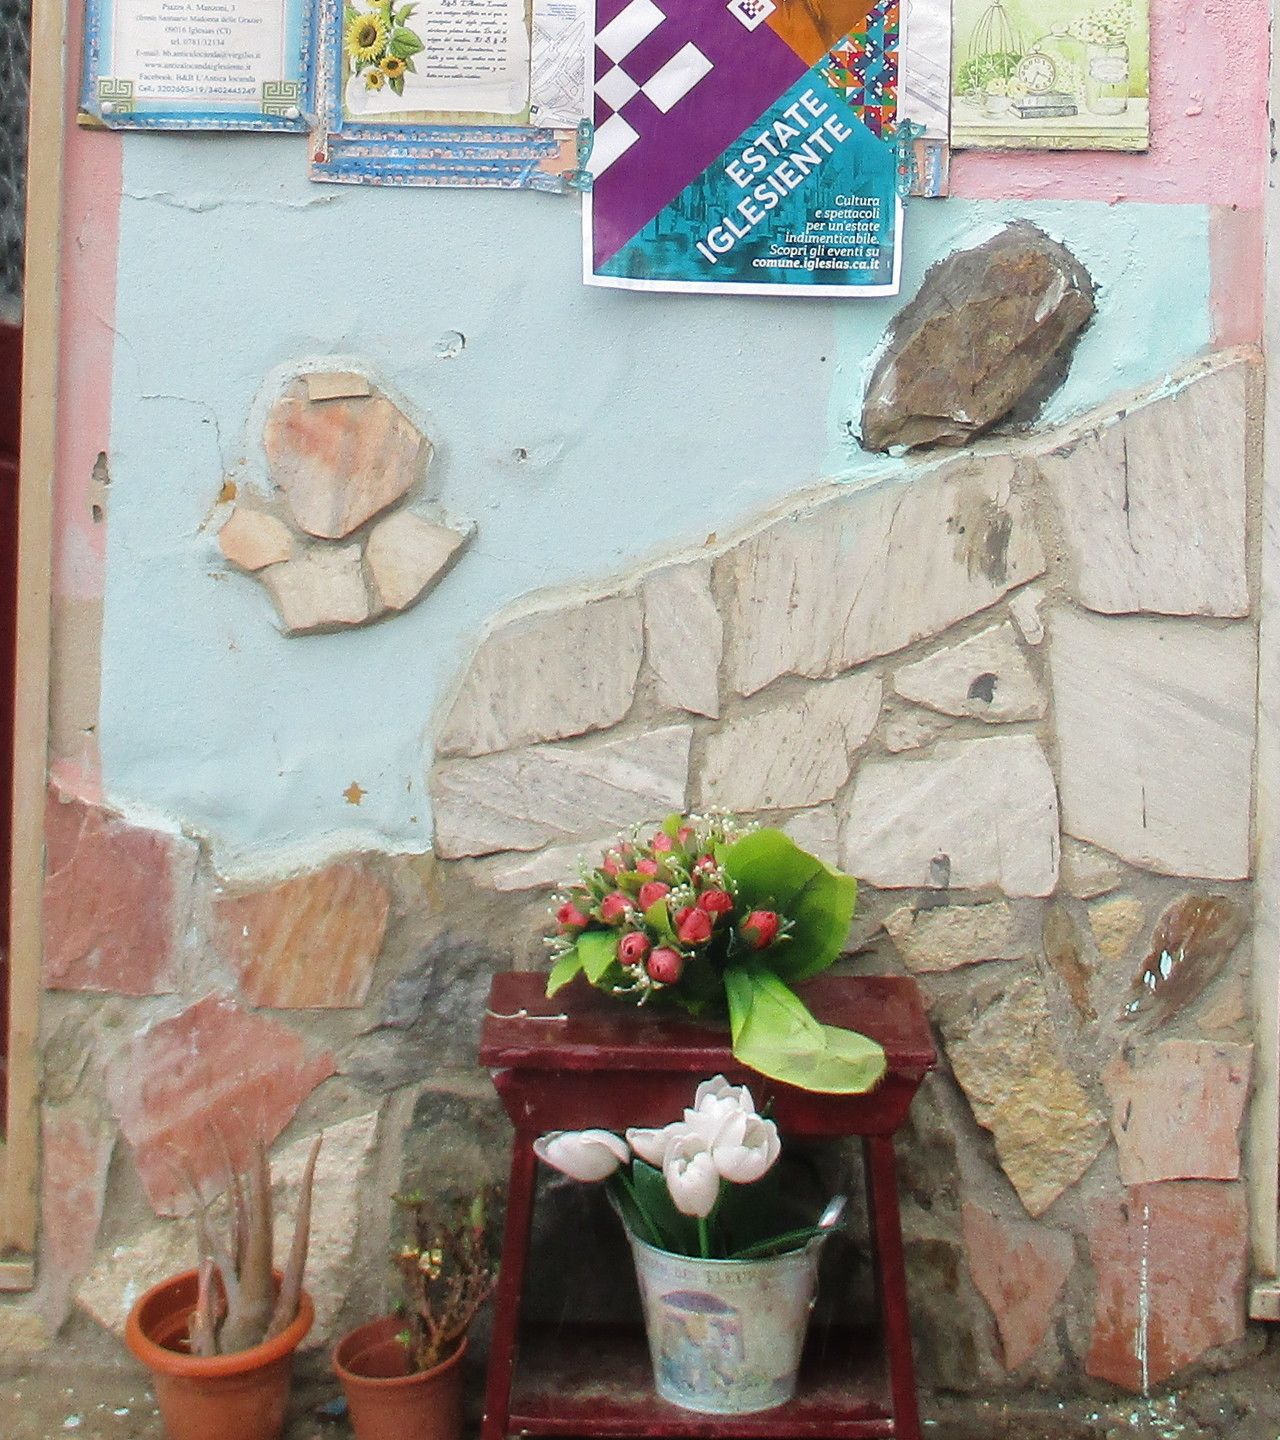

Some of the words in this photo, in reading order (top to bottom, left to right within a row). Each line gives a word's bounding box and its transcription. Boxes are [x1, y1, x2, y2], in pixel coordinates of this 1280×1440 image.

[724, 88, 829, 189] ESTATE
[696, 113, 853, 264] IGLESIENTE
[835, 195, 880, 207] Cultura
[815, 210, 821, 219] e
[824, 209, 880, 220] spettacoli
[806, 221, 825, 234] per
[828, 220, 880, 232] un'estate
[785, 232, 880, 244] indimenticabile.
[770, 244, 807, 257] Scopri
[809, 245, 825, 259] gli
[827, 245, 863, 257] eventi
[865, 247, 880, 257] su
[752, 257, 880, 271] comune.iglesias.ca.it
